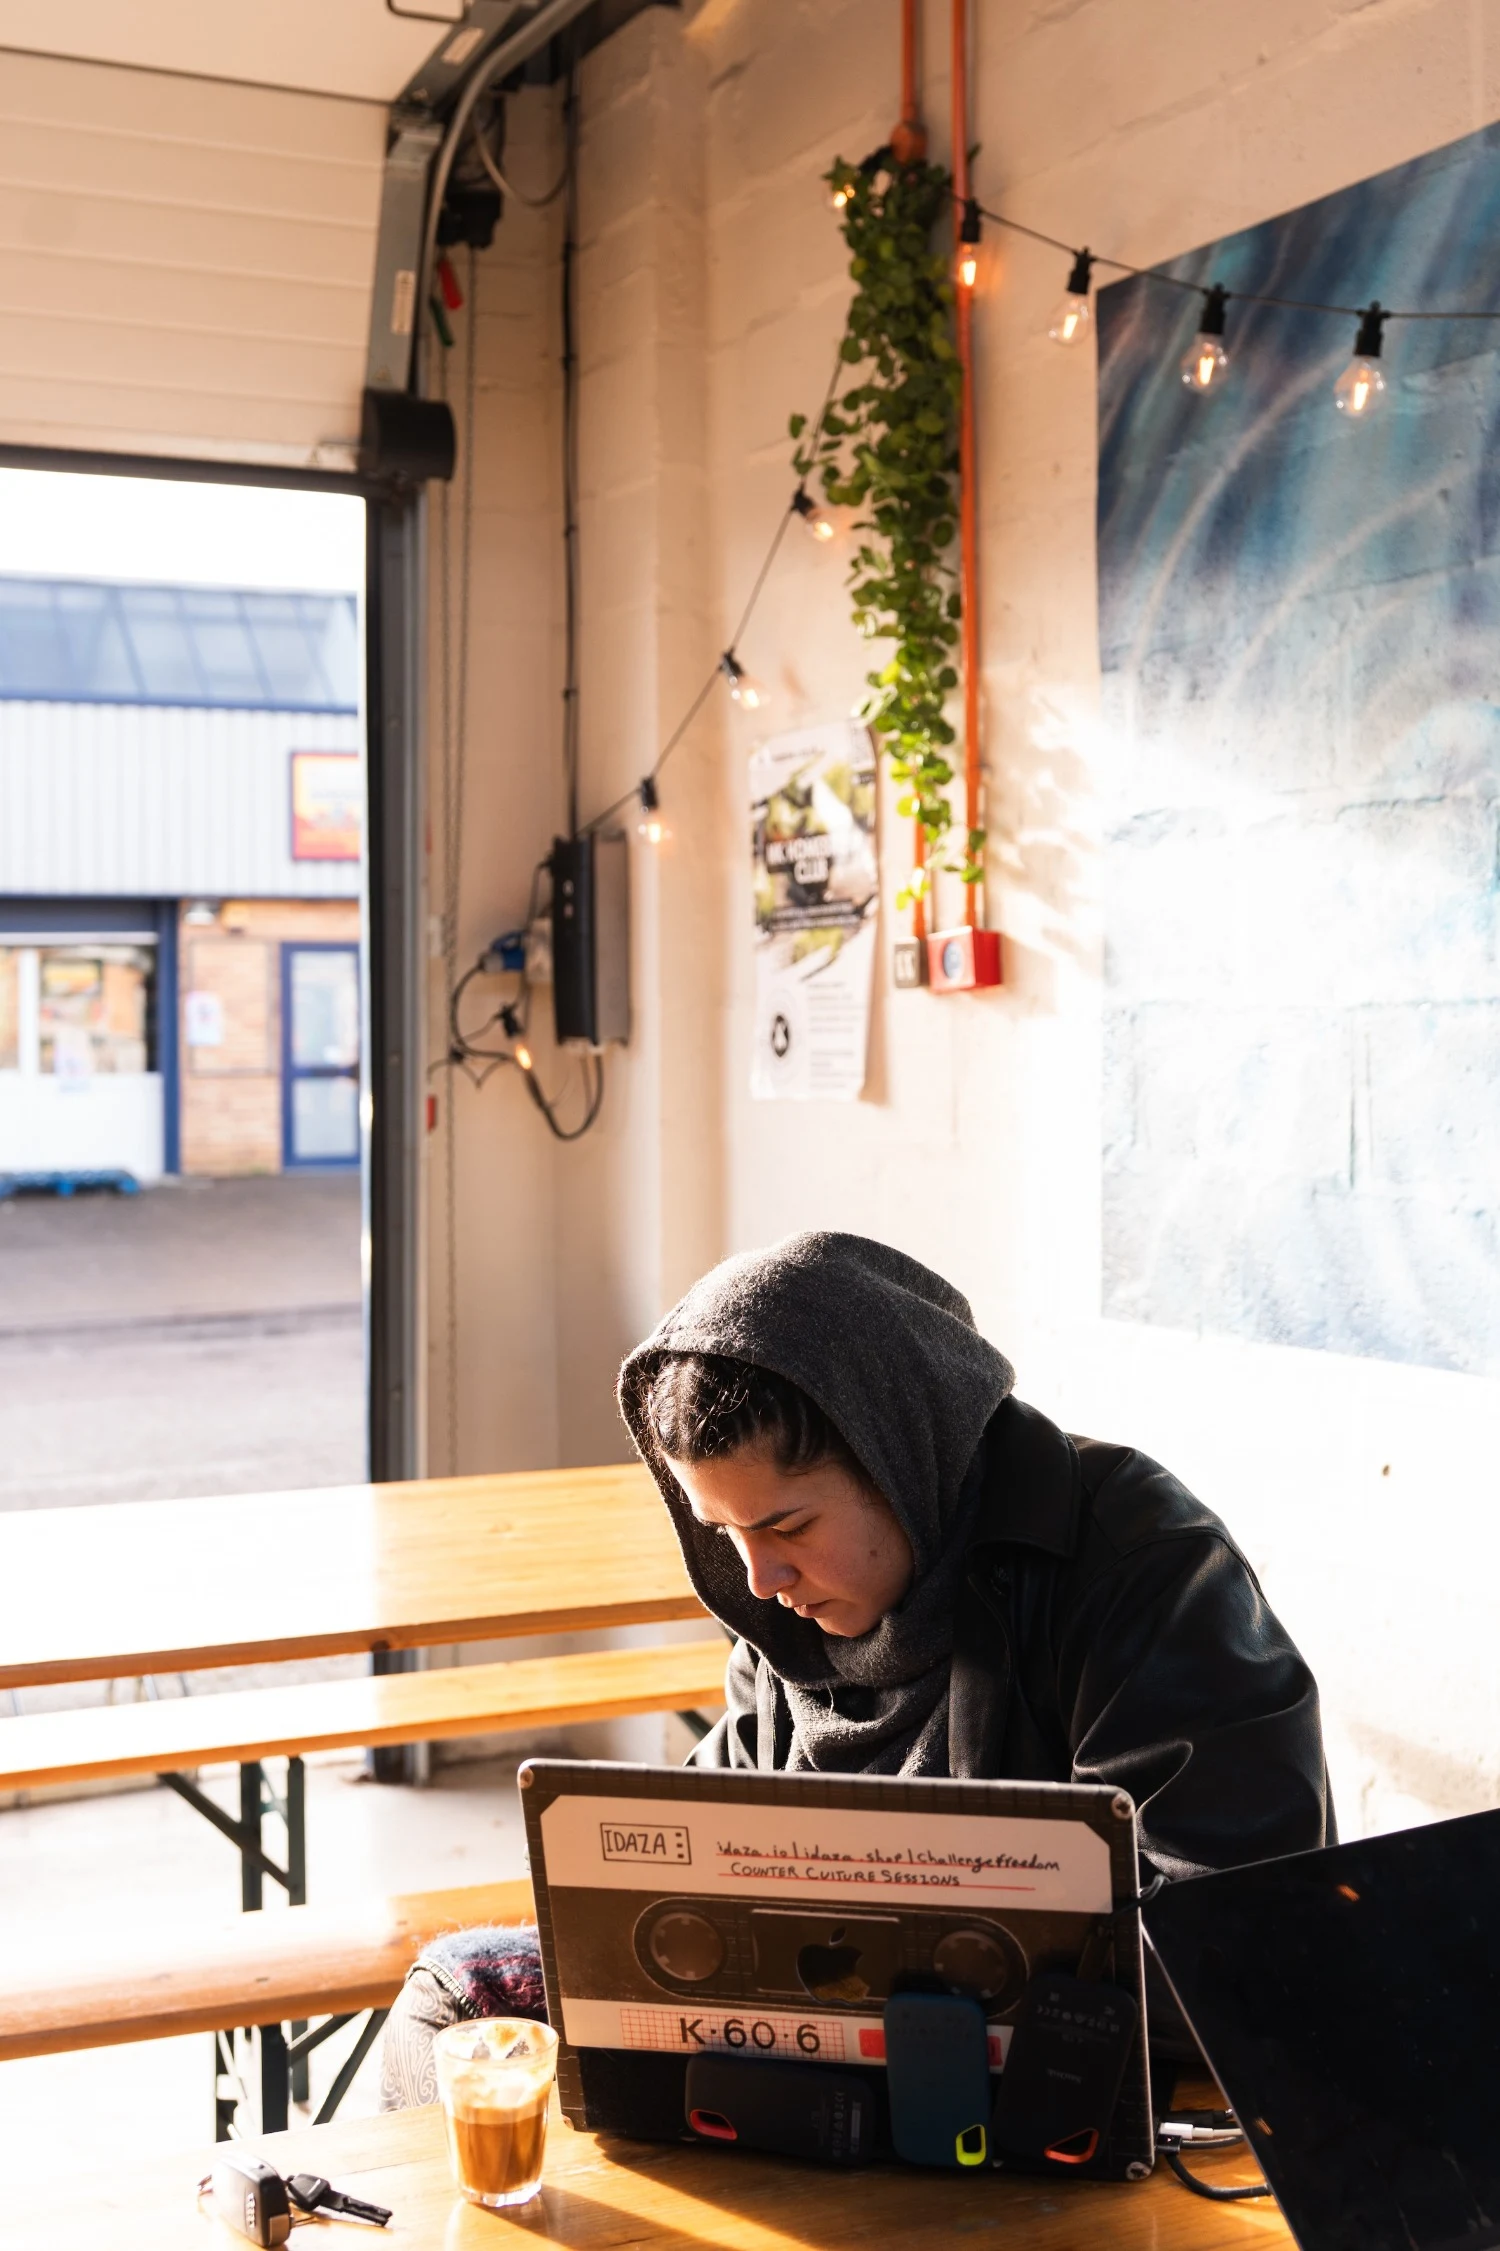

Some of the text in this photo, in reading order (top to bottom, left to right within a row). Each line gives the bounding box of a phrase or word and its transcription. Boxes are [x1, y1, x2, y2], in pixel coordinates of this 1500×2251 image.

[604, 1830, 667, 1856] IDAZA
[731, 1862, 801, 1878] COUNTER
[881, 1869, 961, 1886] SESSIONS
